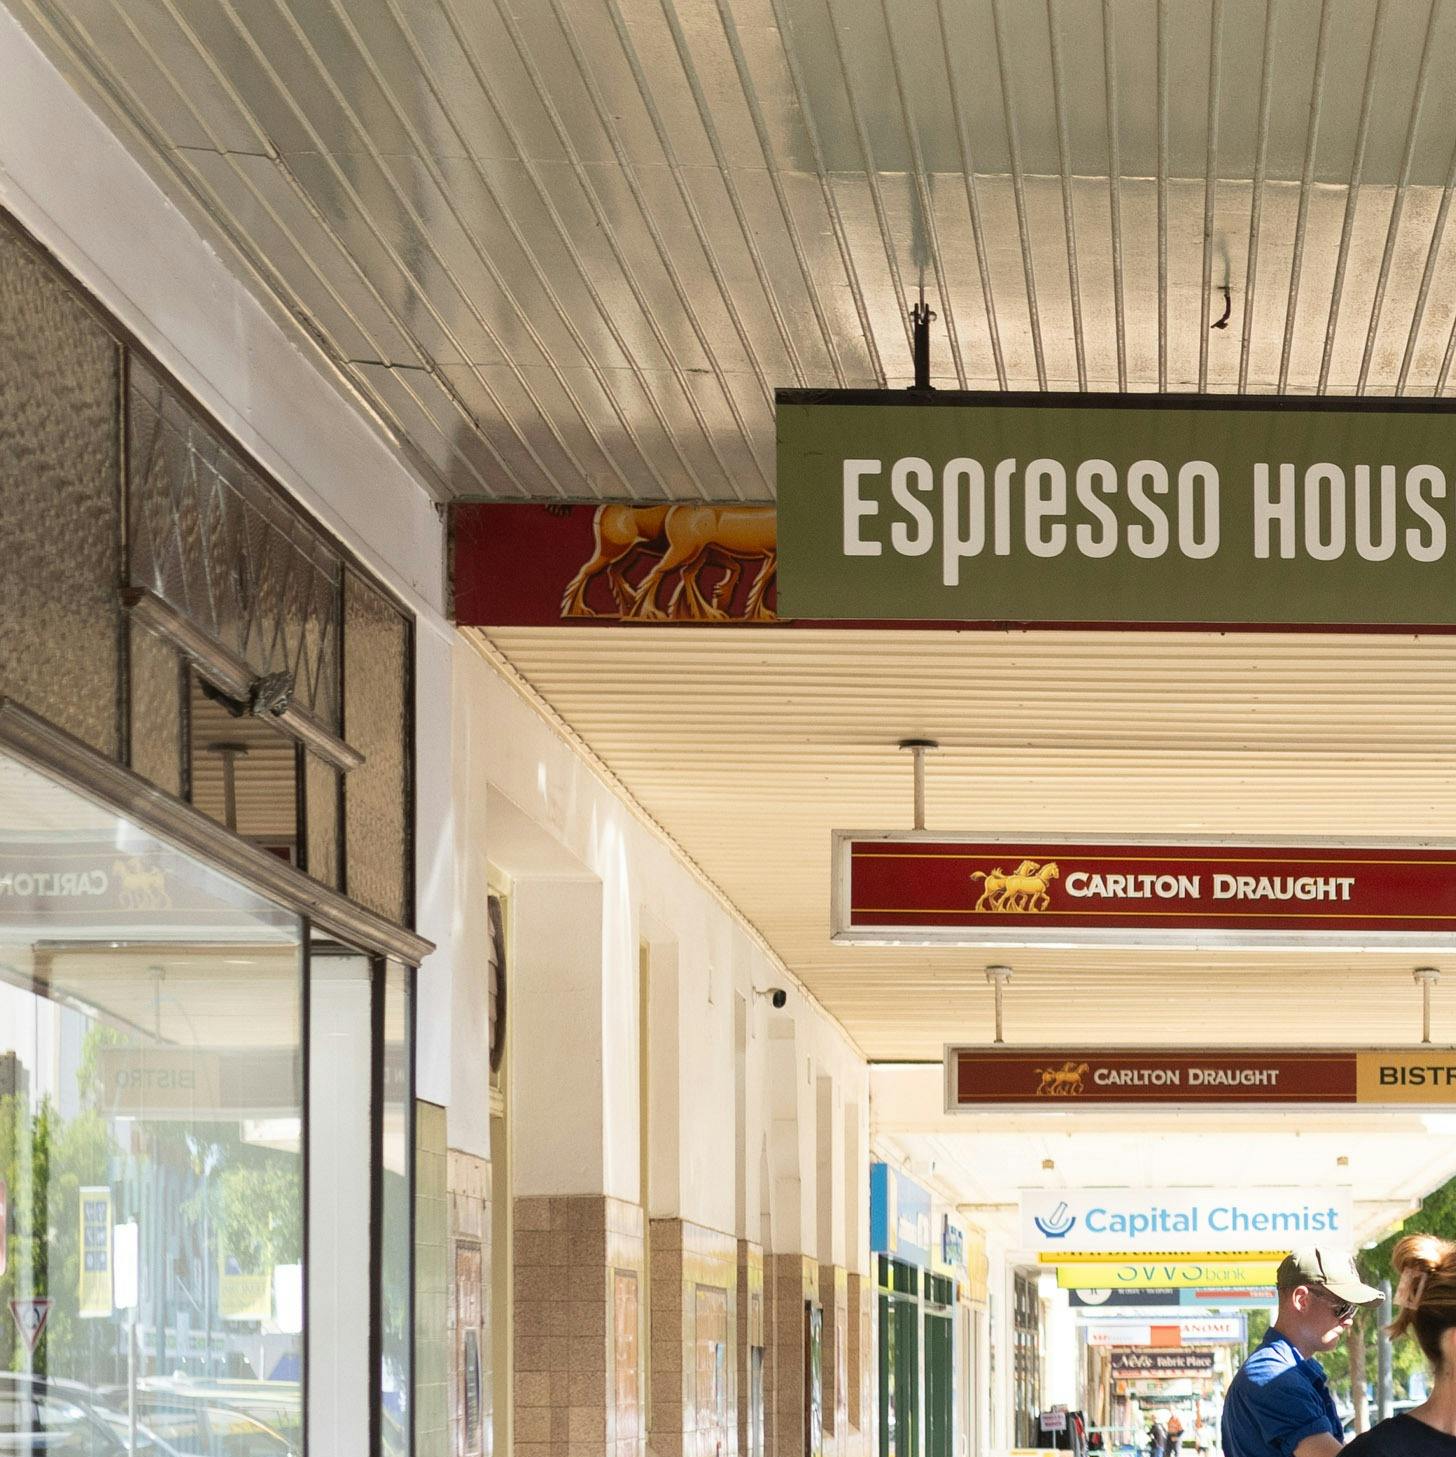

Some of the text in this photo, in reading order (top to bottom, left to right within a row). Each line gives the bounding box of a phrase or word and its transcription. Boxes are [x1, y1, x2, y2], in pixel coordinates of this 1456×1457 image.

[1065, 871, 1356, 901] CARLTON DRAUGHT
[1093, 1069, 1279, 1086] CARLTON DRAUGHT
[1084, 1206, 1339, 1237] Capital Chemist
